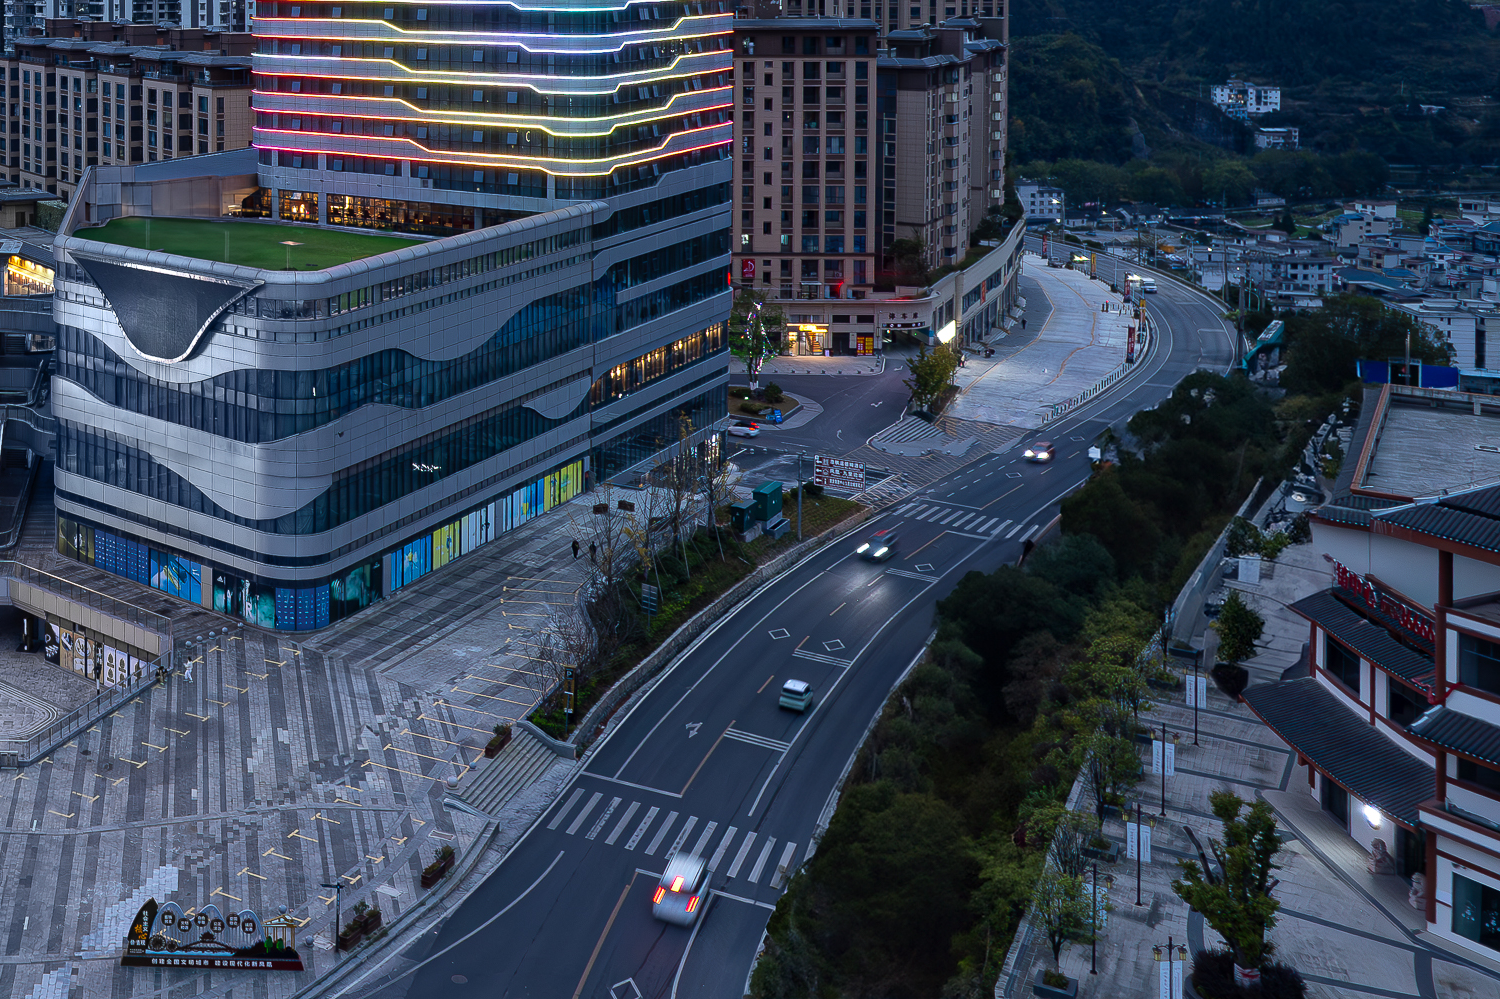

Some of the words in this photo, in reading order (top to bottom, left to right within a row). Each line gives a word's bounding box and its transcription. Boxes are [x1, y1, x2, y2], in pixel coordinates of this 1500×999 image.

[151, 958, 209, 966] 创建全国文明城市
